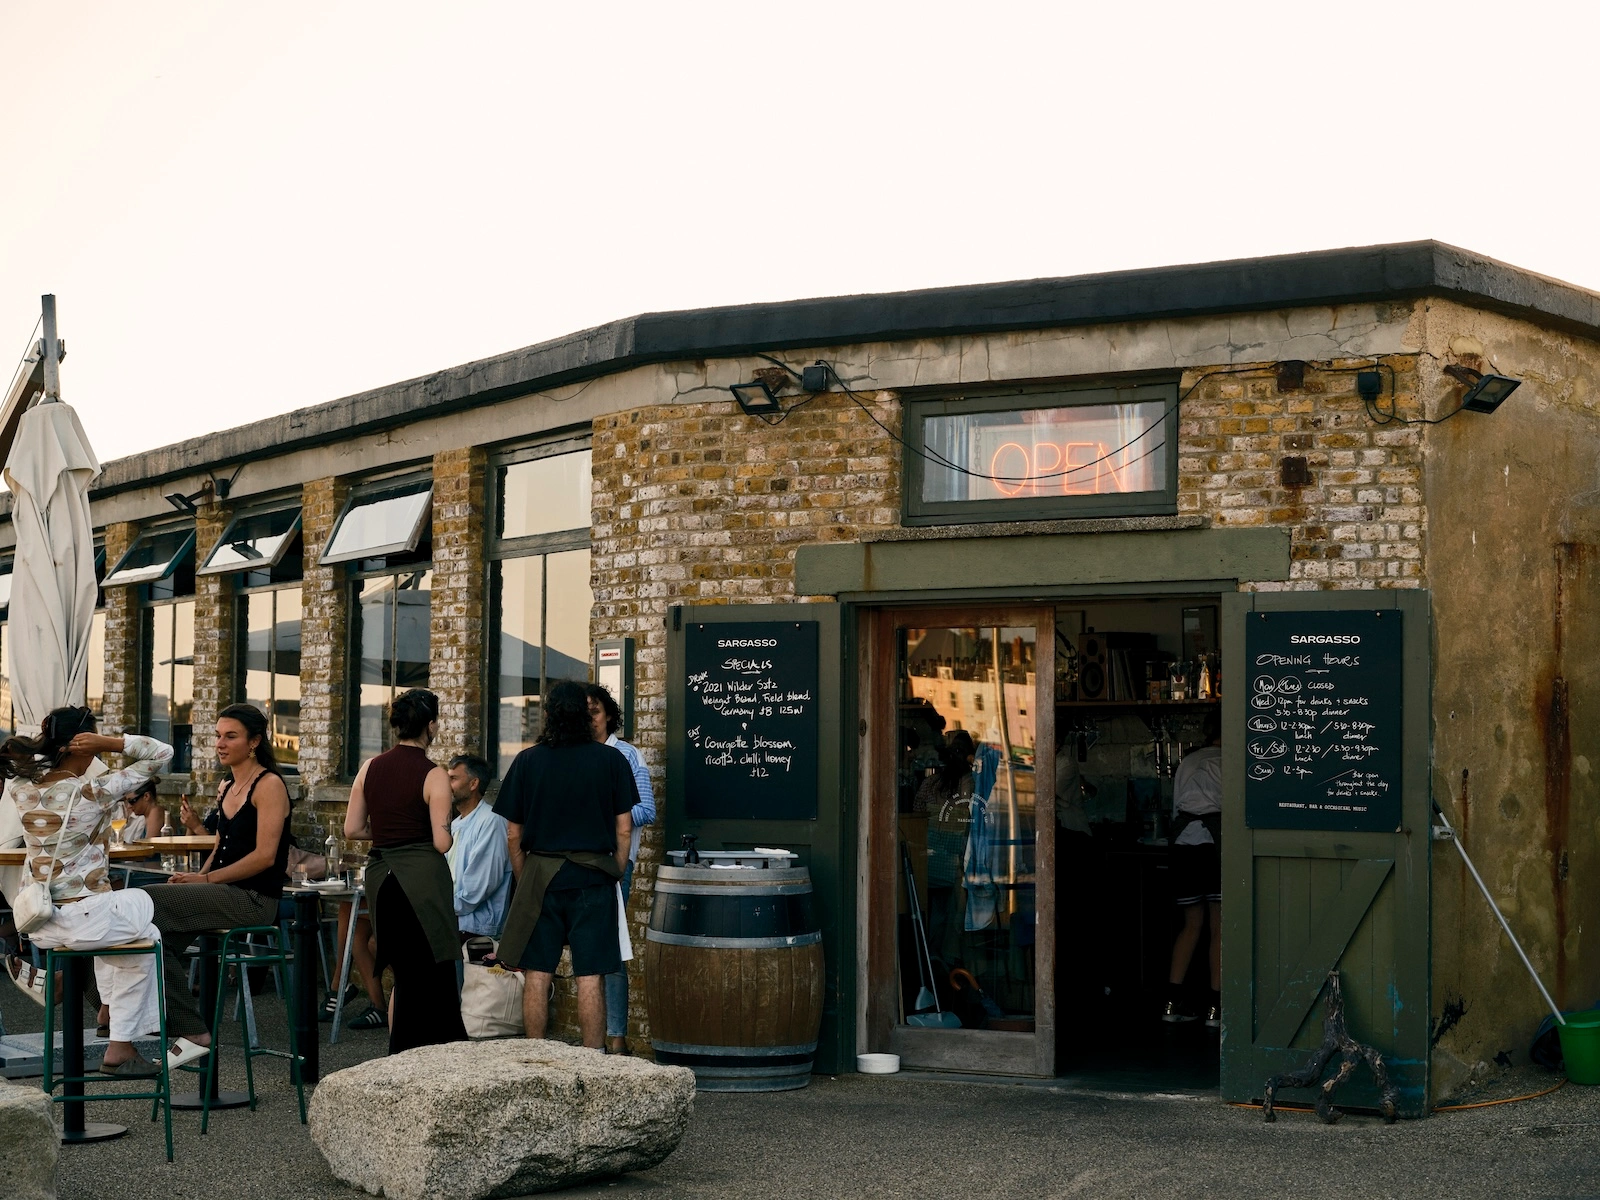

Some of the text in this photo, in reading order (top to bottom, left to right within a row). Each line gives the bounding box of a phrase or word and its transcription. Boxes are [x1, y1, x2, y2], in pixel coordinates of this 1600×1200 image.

[991, 442, 1128, 496] OPEN
[717, 639, 777, 648] SARGASSO
[1290, 635, 1361, 644] SARGASSO
[721, 658, 773, 671] SPECIALS
[1255, 653, 1311, 666] OPENING
[702, 677, 778, 693] 2021 Wilder Satz
[1307, 681, 1335, 690] CLOSED
[701, 693, 732, 710] Weingut
[762, 692, 784, 703] Field
[1277, 696, 1293, 709] 12pm
[1295, 694, 1307, 709] for
[1310, 695, 1333, 706] drinks
[1343, 697, 1369, 706] snacks
[720, 706, 755, 721] Germany
[1322, 707, 1351, 716] dinner
[687, 725, 701, 738] EAT
[1342, 730, 1368, 741] dinner
[704, 735, 749, 755] Courgette
[739, 751, 761, 766] chilli
[764, 750, 792, 772] honey
[1341, 751, 1365, 761] dinner
[1377, 779, 1389, 792] day
